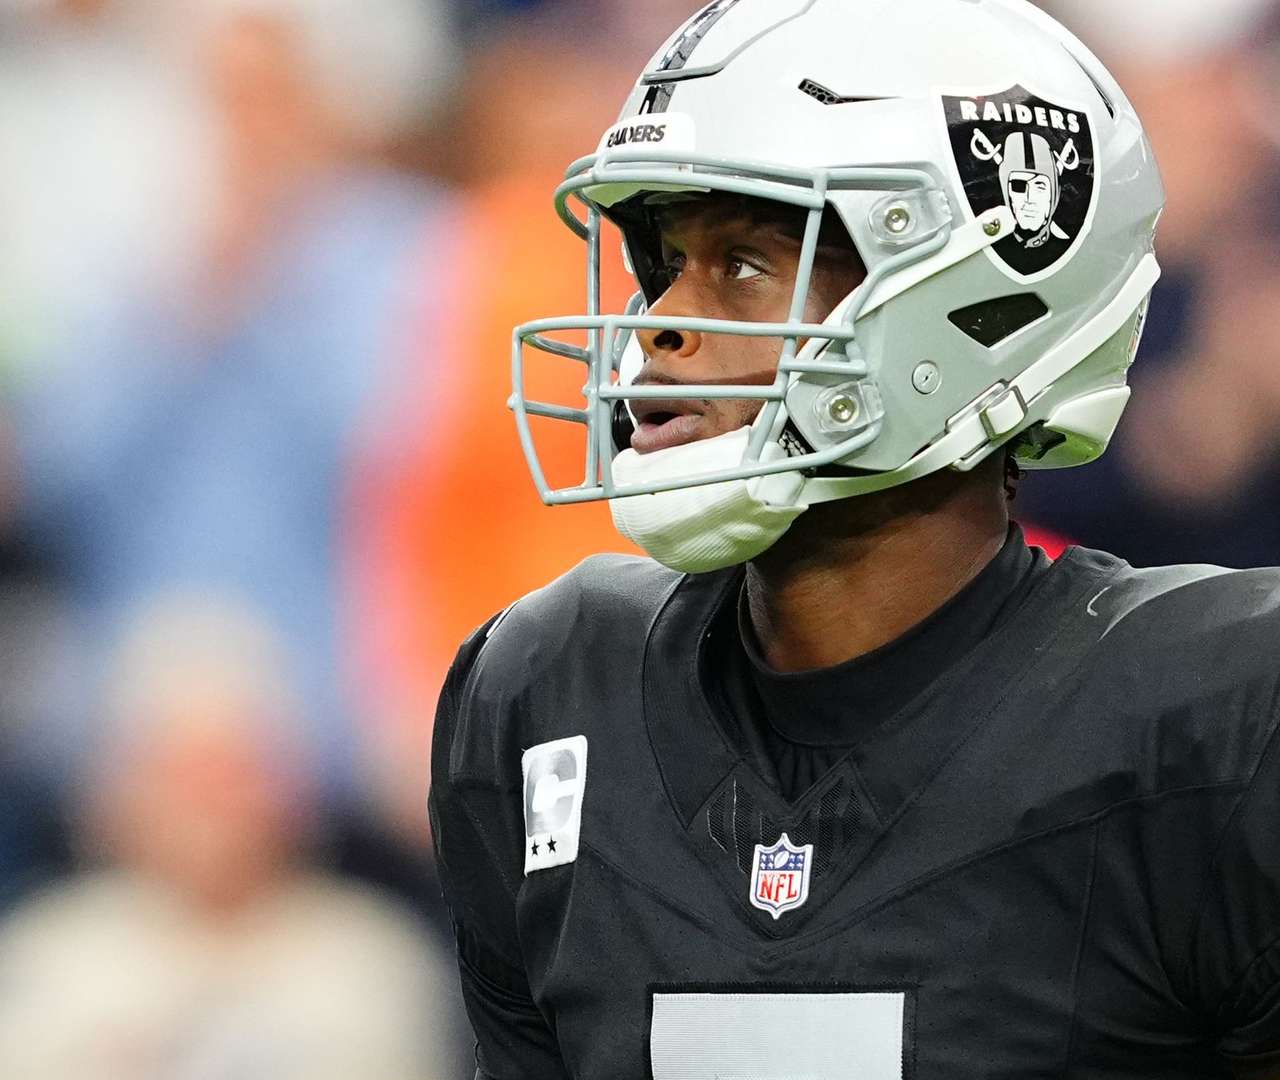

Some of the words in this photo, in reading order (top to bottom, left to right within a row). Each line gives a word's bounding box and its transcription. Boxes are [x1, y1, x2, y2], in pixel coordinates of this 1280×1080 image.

[958, 100, 1081, 134] RAIDERS
[525, 748, 577, 838] C
[758, 873, 798, 903] NFL
